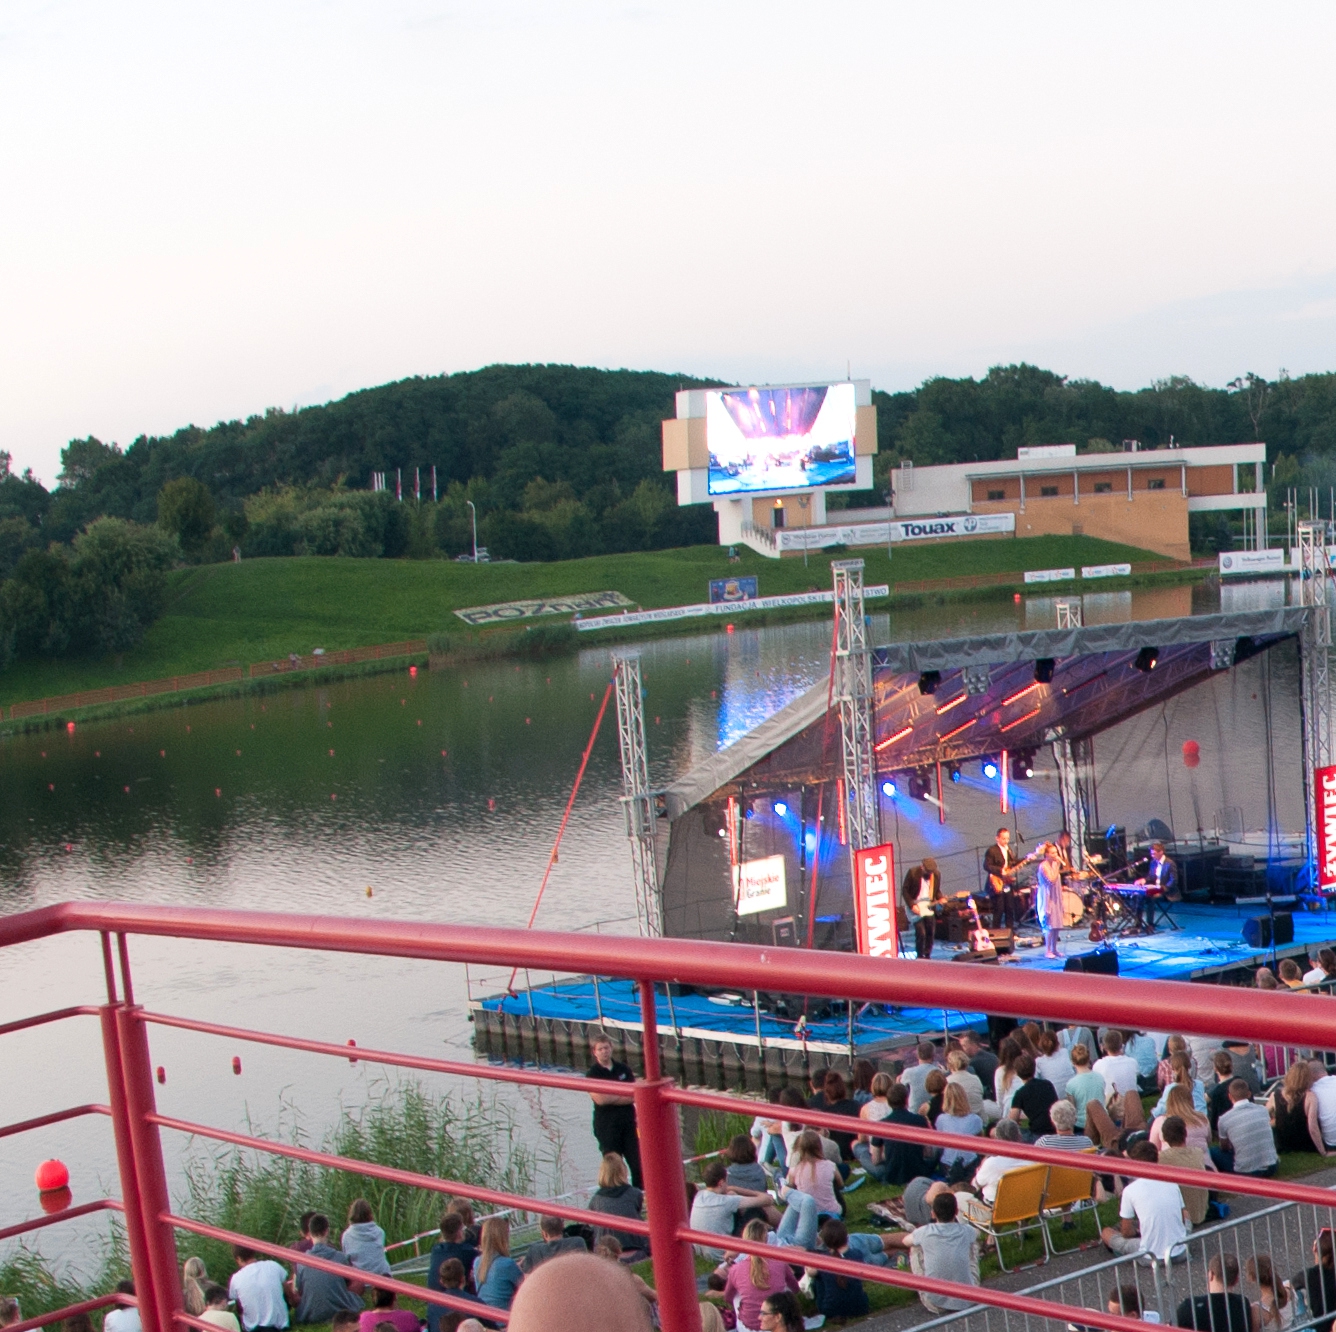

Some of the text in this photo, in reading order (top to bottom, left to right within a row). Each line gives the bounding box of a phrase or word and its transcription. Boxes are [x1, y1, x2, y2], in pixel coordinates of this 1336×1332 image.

[901, 518, 956, 537] Touax
[715, 600, 758, 612] FUNDACJA
[864, 855, 892, 958] YWIEC
